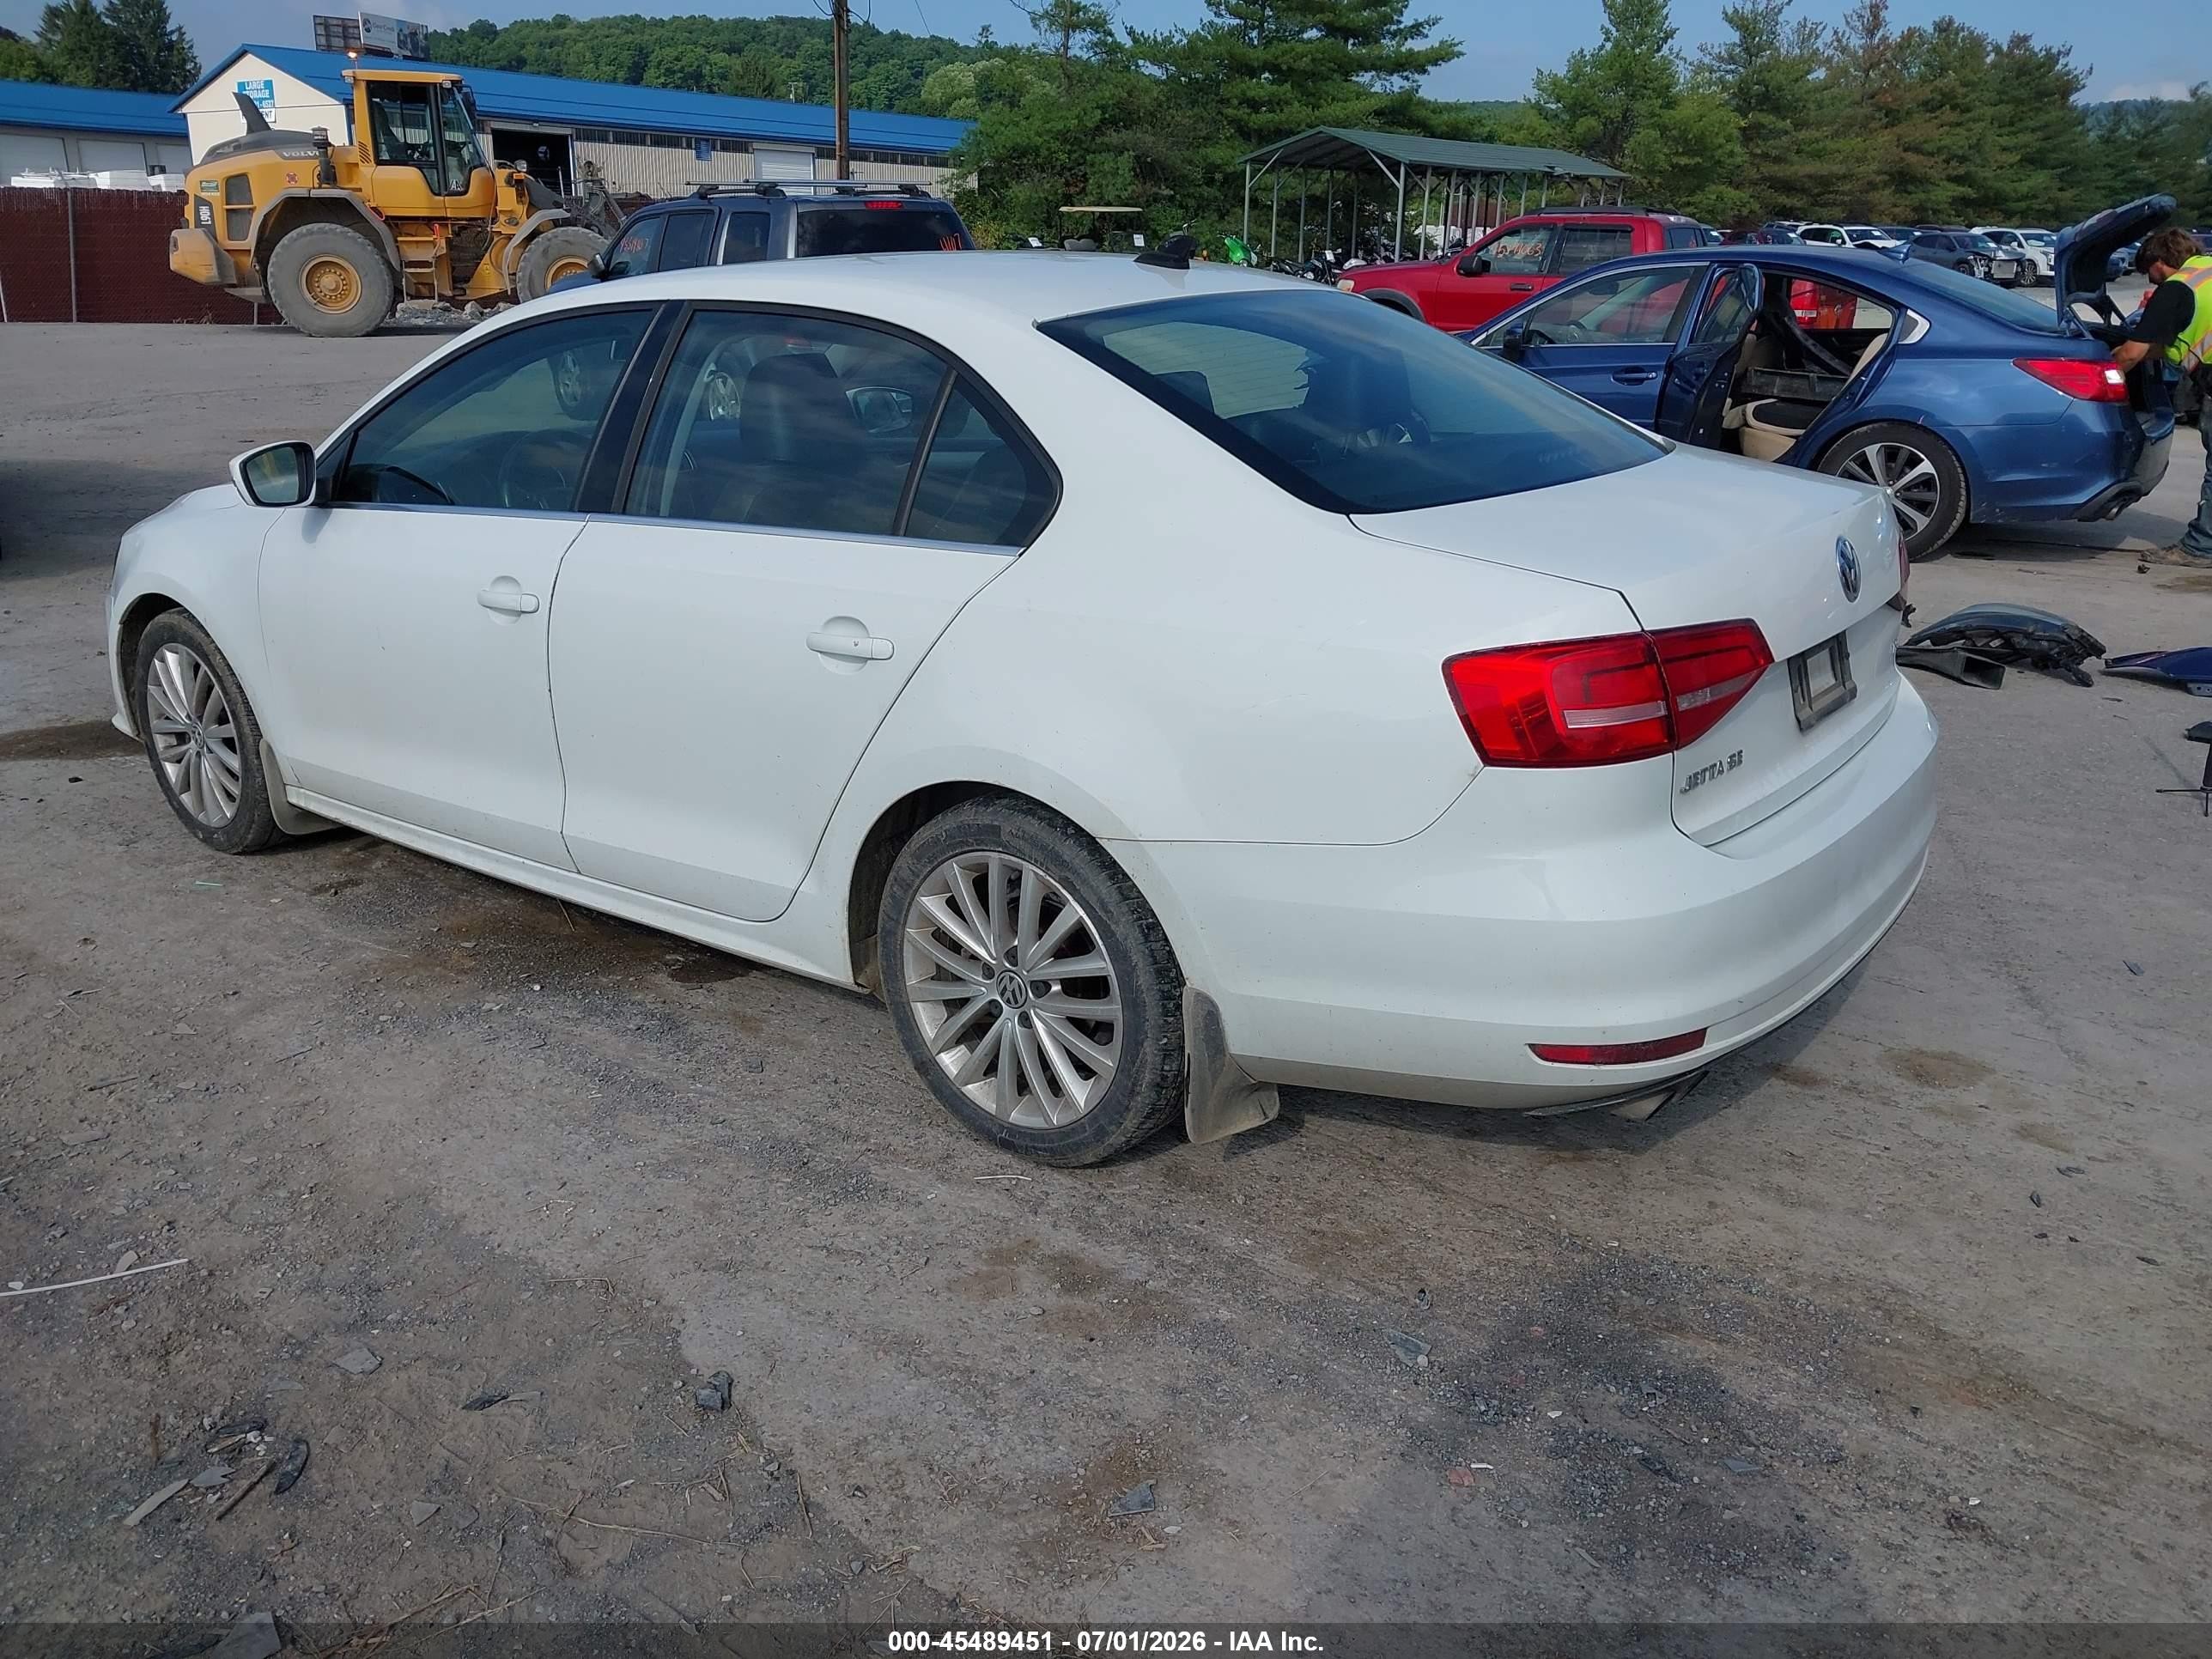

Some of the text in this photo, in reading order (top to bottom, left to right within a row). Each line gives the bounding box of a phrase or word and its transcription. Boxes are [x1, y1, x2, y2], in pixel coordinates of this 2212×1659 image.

[245, 81, 265, 90] LARGE
[199, 205, 212, 225] L90H
[1680, 749, 1743, 794] JETTA SE
